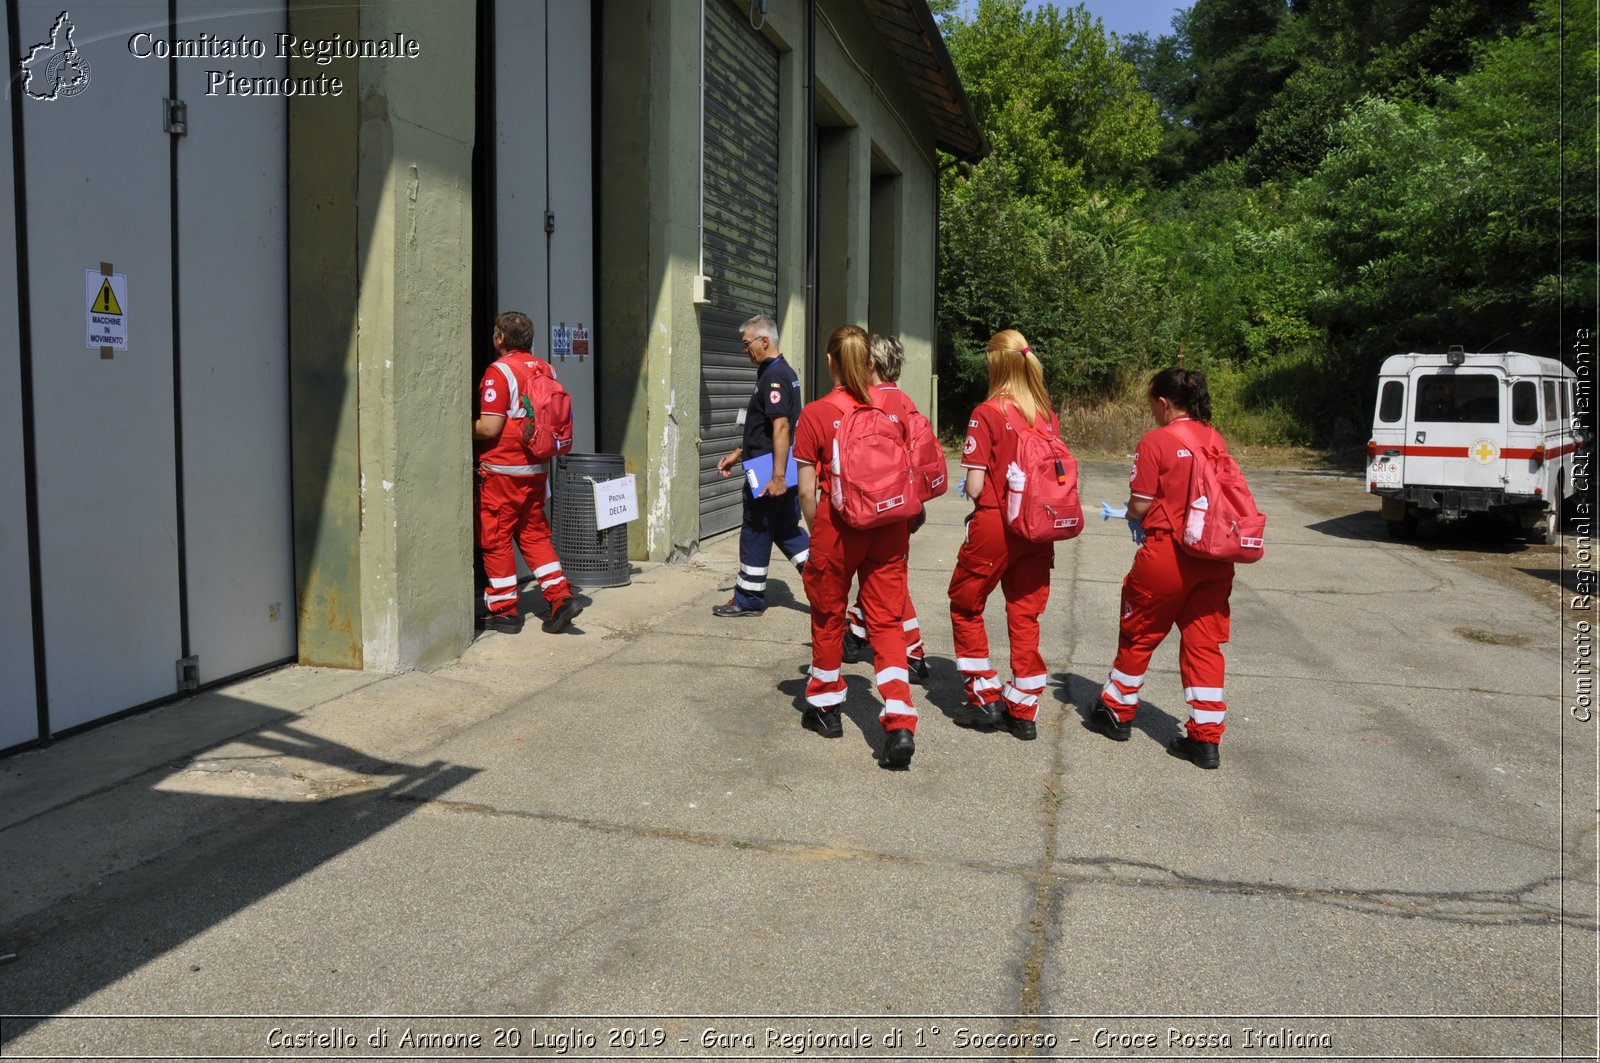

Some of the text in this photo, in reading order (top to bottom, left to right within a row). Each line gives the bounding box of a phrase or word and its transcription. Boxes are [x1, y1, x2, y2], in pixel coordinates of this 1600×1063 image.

[92, 316, 121, 325] MACCHINE
[90, 335, 123, 344] MOVIMENTO
[1372, 462, 1387, 472] CRI
[609, 494, 625, 503] PROVA
[609, 505, 627, 515] DELTA
